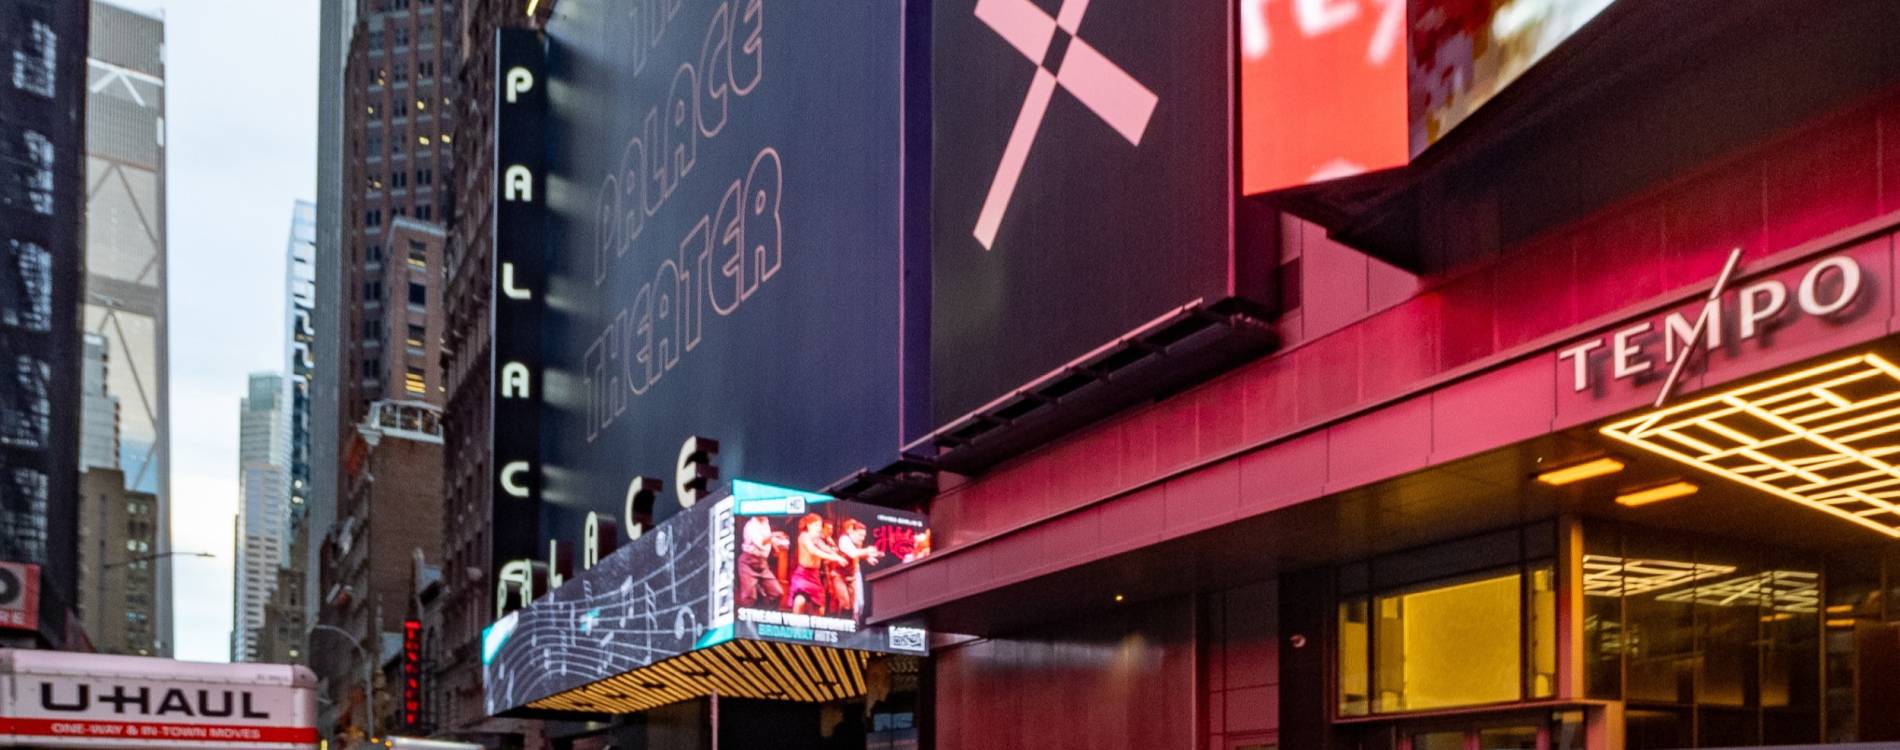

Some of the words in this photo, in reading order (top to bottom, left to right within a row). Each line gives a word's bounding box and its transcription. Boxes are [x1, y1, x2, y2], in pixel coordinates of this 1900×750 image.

[594, 0, 763, 286] PALACE
[582, 146, 783, 443] THEATER
[1559, 247, 1862, 407] TEMPO
[758, 624, 814, 640] BROADWAY
[41, 681, 270, 719] U-HAUL
[51, 722, 123, 735] ONE-WAY
[126, 724, 139, 736] &
[141, 725, 207, 738] IN-TOWN
[209, 726, 261, 739] MOVES
